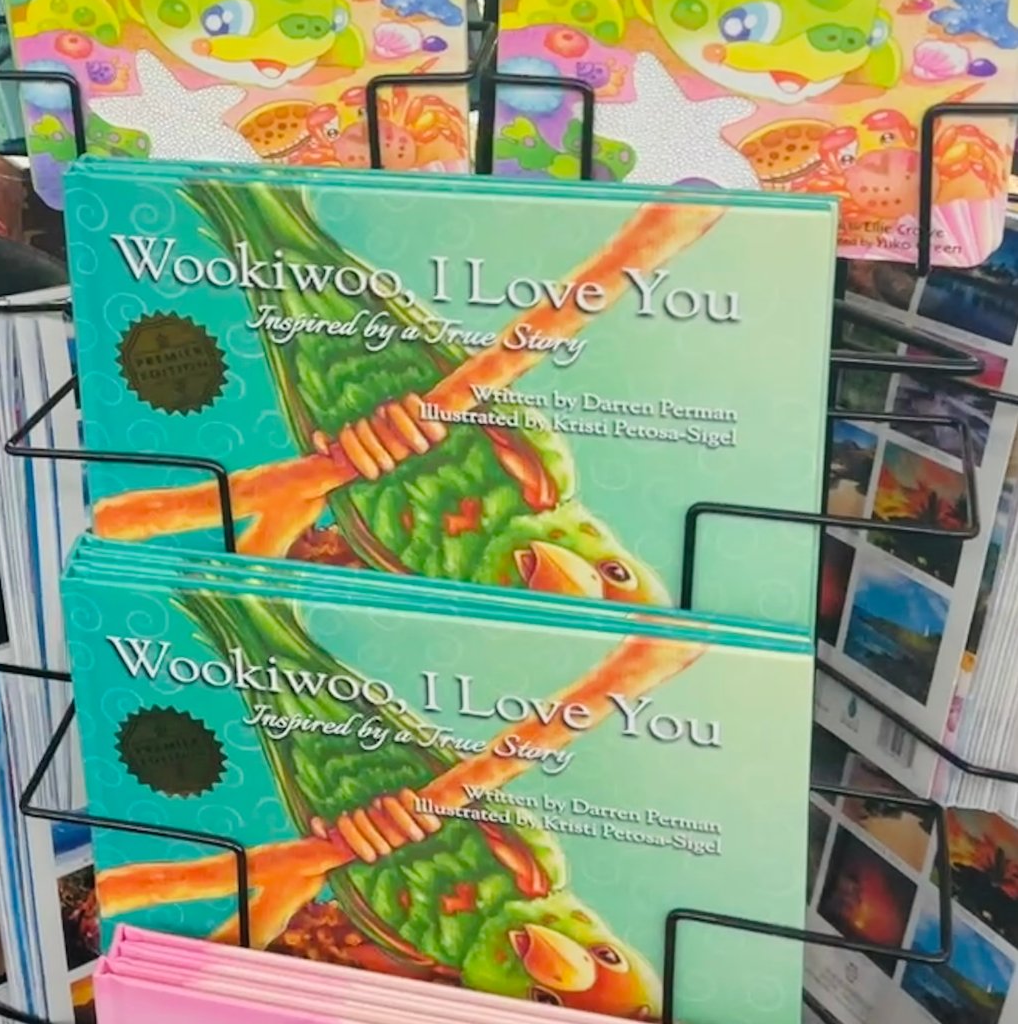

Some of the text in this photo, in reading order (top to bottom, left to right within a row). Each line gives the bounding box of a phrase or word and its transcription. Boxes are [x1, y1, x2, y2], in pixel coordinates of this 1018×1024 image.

[111, 234, 740, 321] Wookiwoo, I Love You
[246, 304, 587, 366] Inspired by a True Story
[420, 403, 737, 447] Illustrated by Kristi Petosa-Sigel
[470, 384, 737, 422] Written by Darren Perman
[107, 636, 721, 747] Wookiwoo, I Love You
[243, 704, 575, 774] Inspired by a True Story
[414, 797, 721, 854] Illustrated by Kristi Petosa-Sigel
[463, 784, 721, 833] Written by Darren Perman
